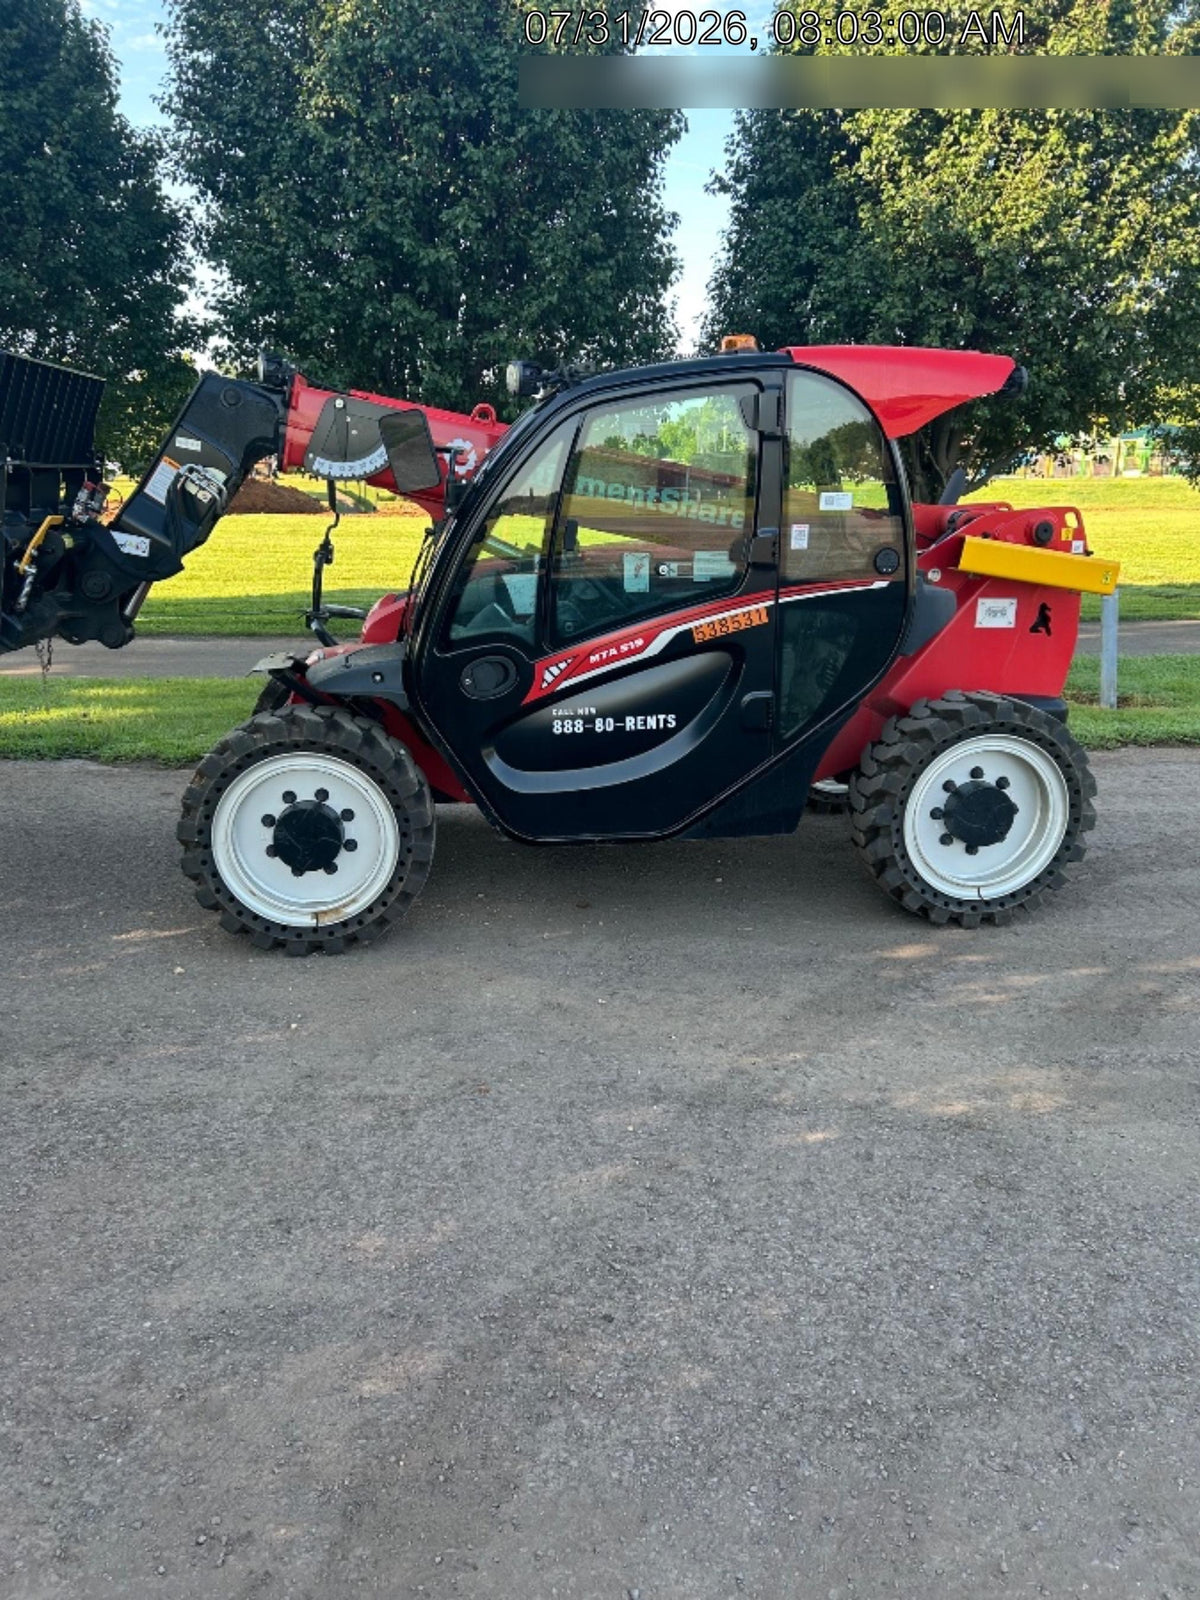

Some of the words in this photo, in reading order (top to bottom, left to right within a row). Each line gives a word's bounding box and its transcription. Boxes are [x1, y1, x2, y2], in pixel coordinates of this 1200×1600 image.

[694, 608, 767, 641] 538531
[589, 647, 619, 665] MTA
[552, 714, 677, 735] 888-80-RENTS
